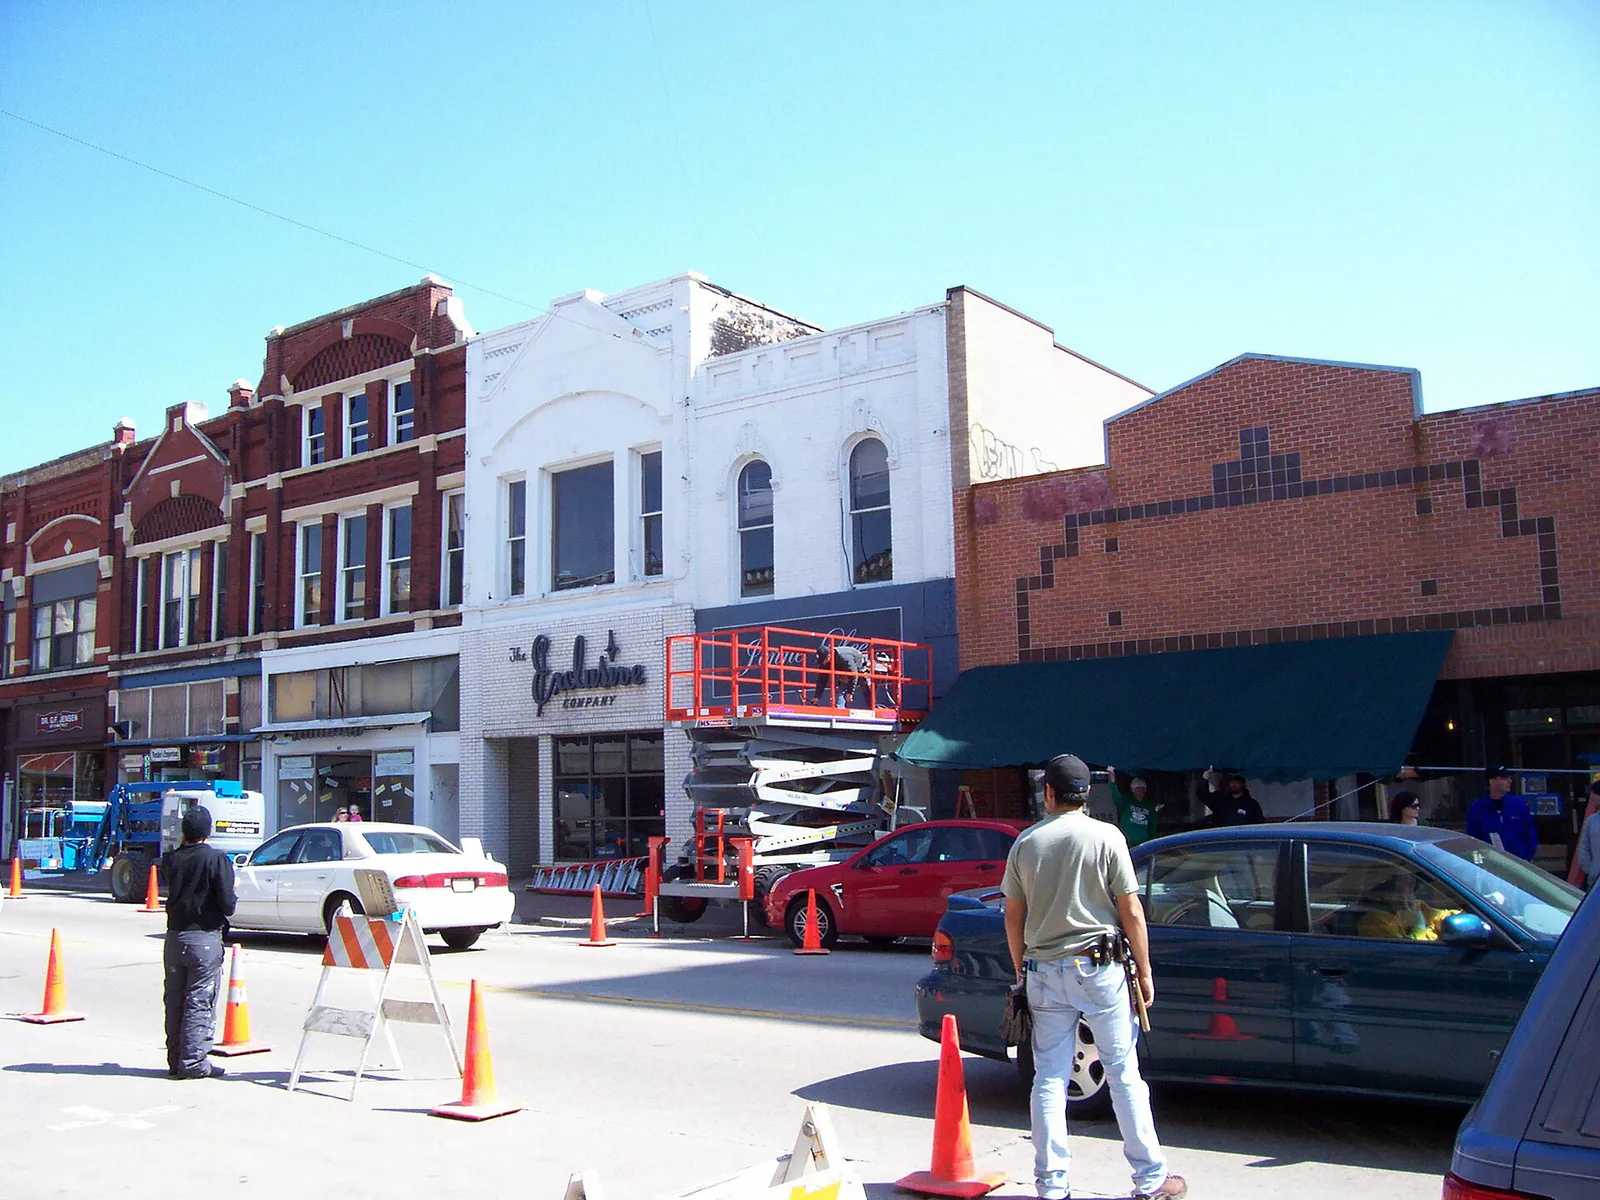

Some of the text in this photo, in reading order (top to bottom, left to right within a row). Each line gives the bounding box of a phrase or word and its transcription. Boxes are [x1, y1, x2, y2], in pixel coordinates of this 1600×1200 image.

[509, 630, 646, 717] The Exclusive
[562, 695, 617, 709] COMPANY
